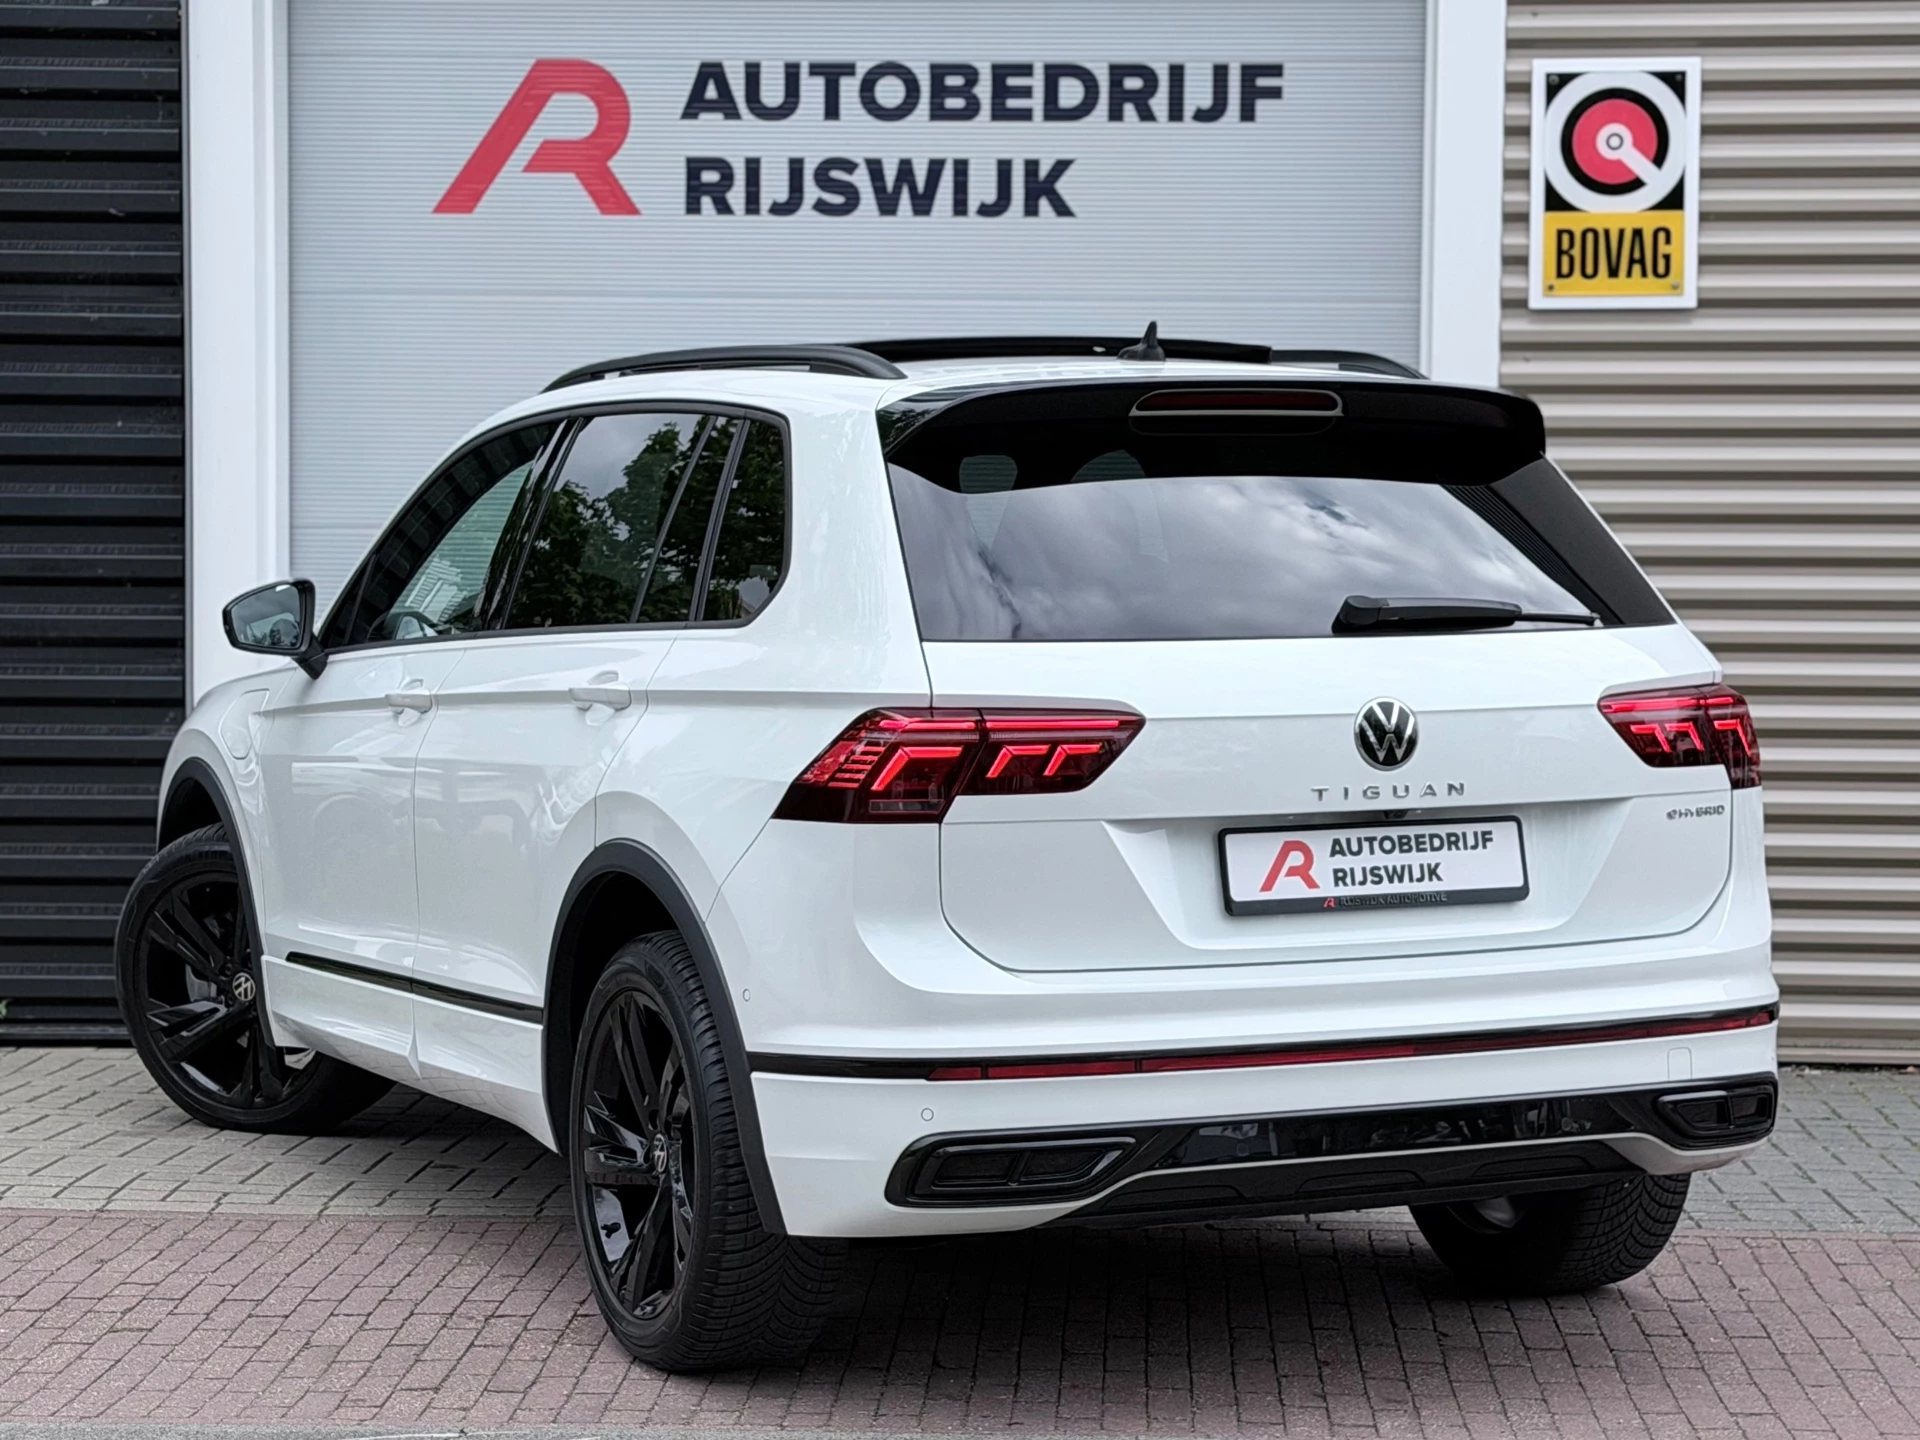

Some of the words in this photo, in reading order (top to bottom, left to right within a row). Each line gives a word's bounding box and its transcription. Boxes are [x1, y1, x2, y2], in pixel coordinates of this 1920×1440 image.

[680, 61, 1284, 123] AUTOBEDRIJF
[684, 157, 1077, 218] RIJSWIJK
[1555, 226, 1672, 280] BOVAG
[1310, 782, 1465, 802] TIGUAN
[1328, 829, 1494, 858] AUTOBEDRIJF
[1332, 862, 1443, 888] RIJSWIJK
[1387, 891, 1447, 904] AUTOMOTIVE
